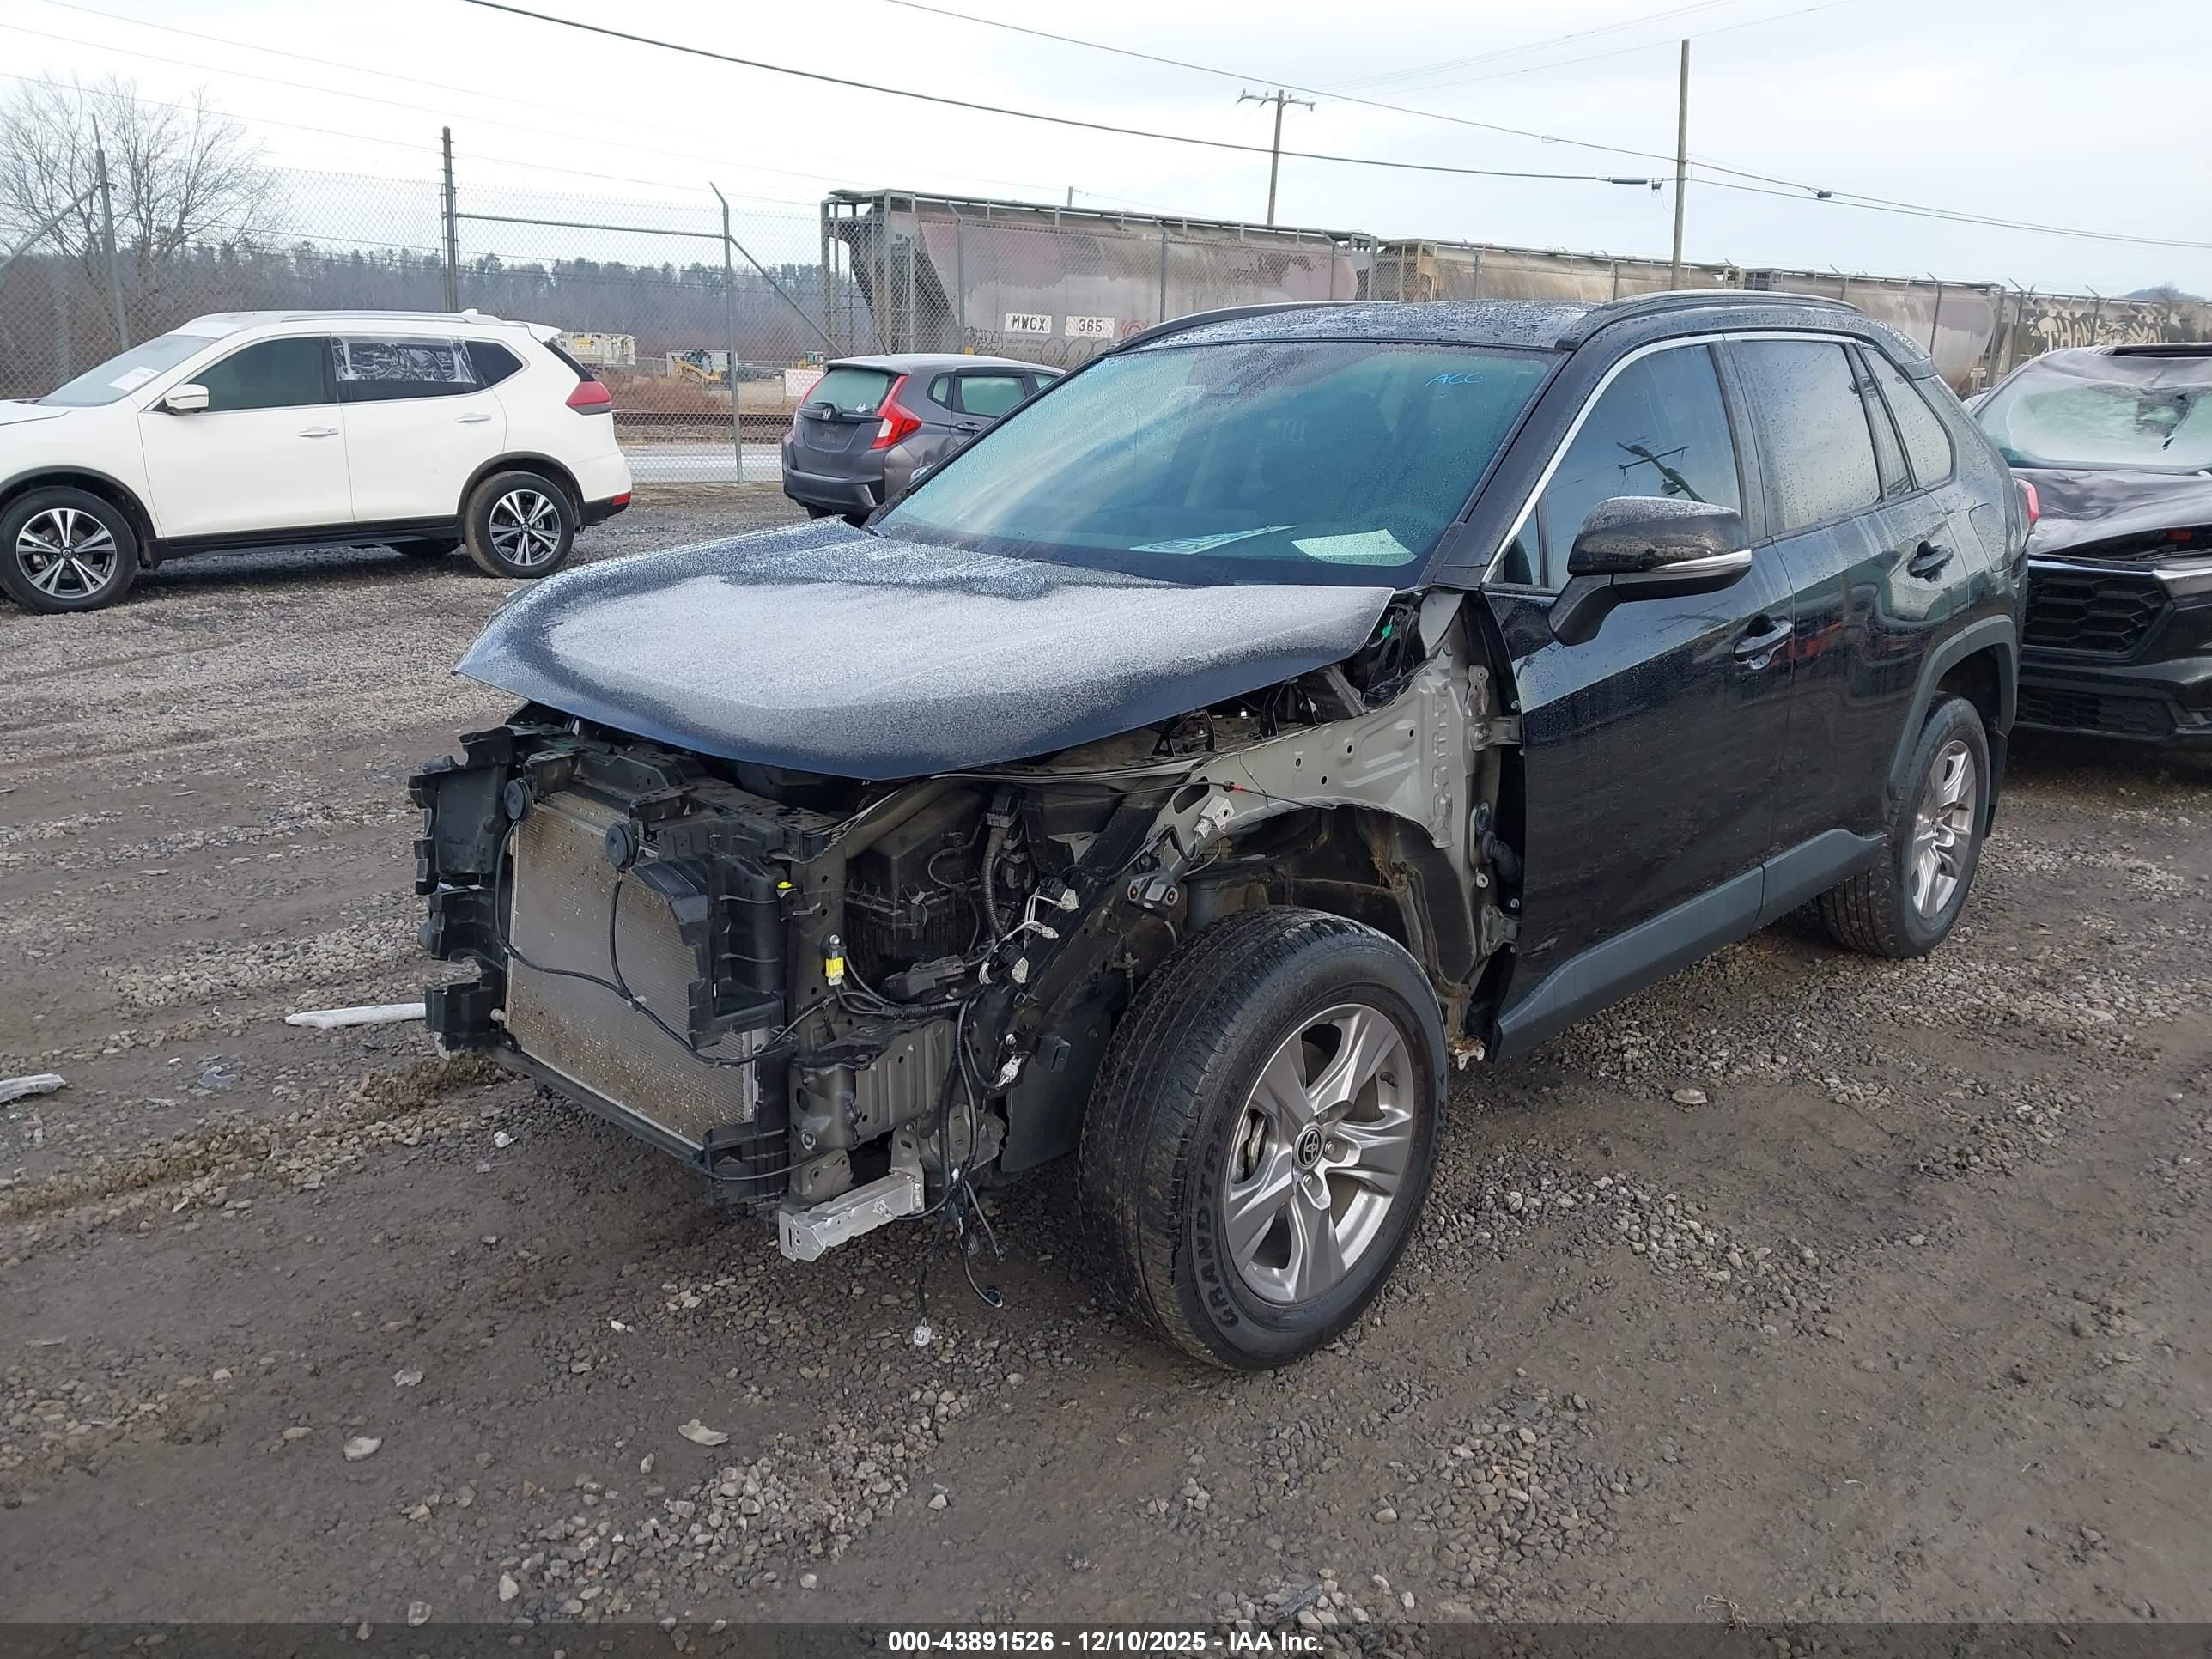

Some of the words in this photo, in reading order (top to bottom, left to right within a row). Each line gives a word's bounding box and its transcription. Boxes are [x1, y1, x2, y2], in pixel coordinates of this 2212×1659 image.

[1012, 315, 1047, 331] MWCX
[1079, 319, 1103, 333] 365
[1425, 371, 1481, 386] ACC
